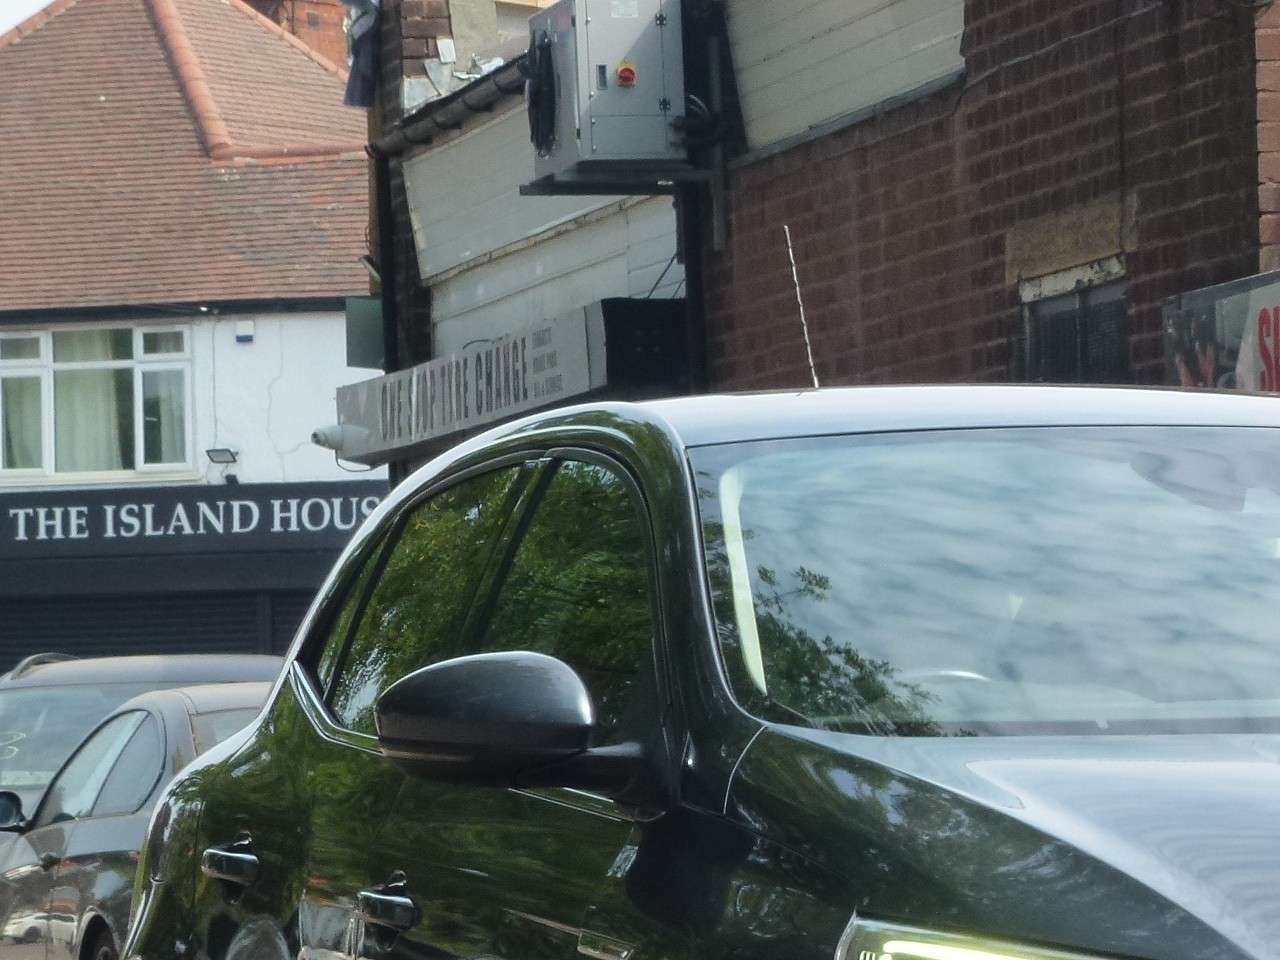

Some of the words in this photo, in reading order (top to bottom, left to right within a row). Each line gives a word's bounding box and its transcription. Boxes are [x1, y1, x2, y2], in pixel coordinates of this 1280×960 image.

[475, 336, 528, 416] CHANGE
[9, 506, 89, 541] THE
[103, 500, 260, 539] ISLAND
